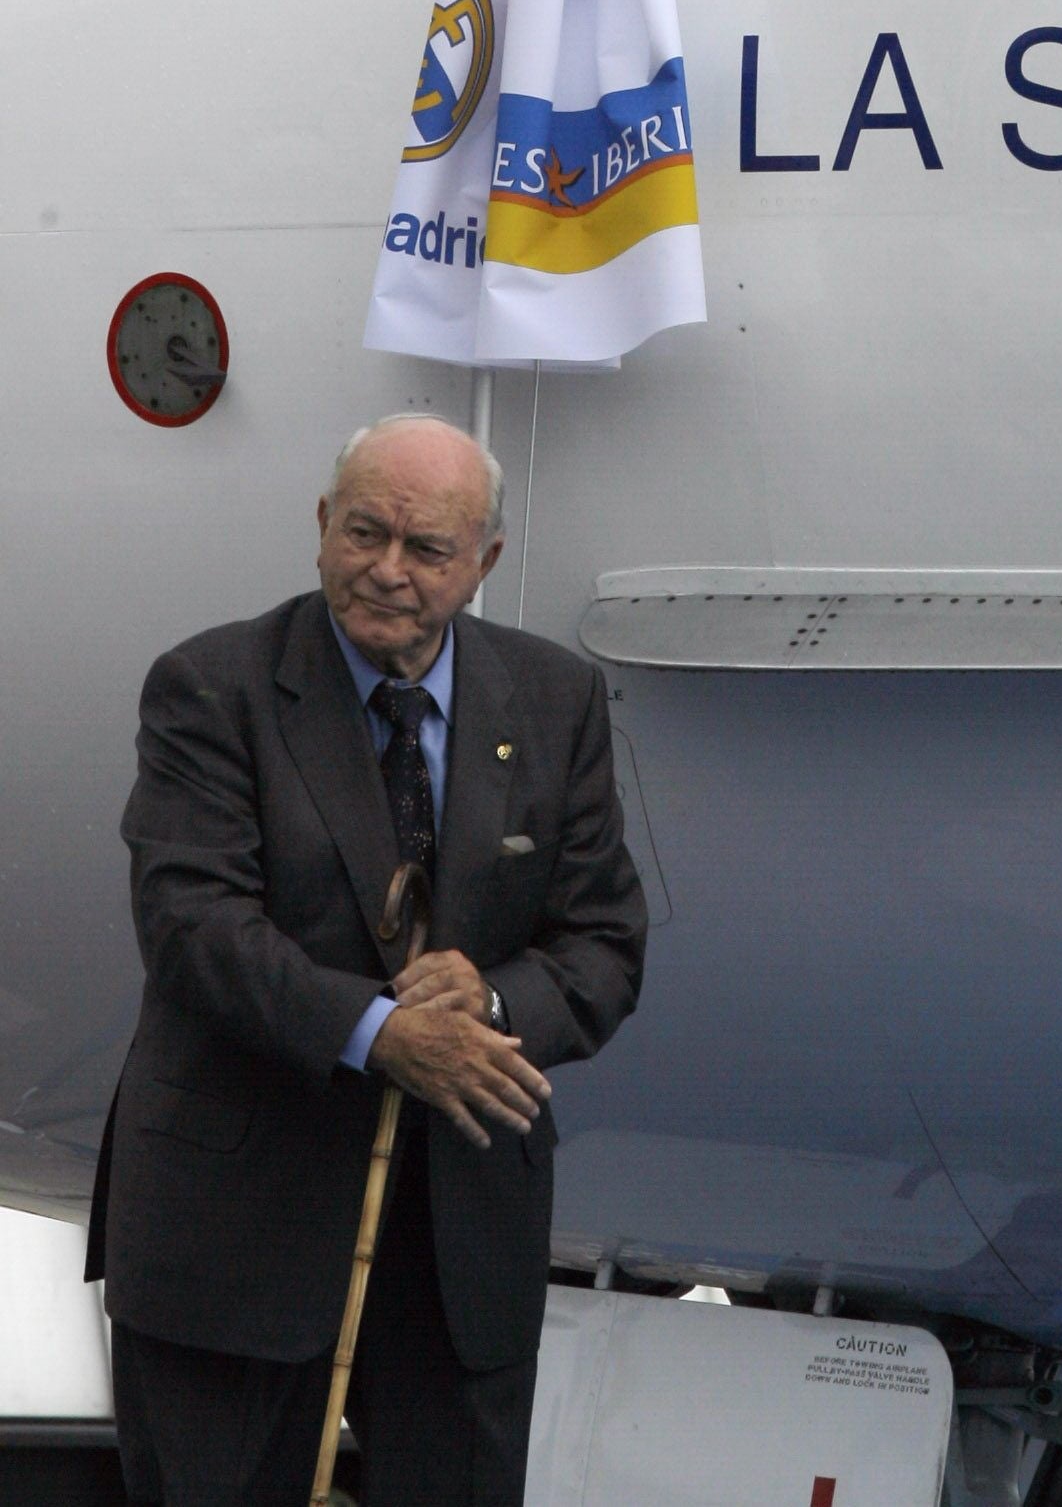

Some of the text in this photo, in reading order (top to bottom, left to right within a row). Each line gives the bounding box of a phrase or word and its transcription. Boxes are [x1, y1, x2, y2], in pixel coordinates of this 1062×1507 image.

[739, 32, 944, 173] LA
[492, 141, 547, 195] ES
[591, 105, 693, 196] IBERI
[382, 210, 487, 269] adri
[836, 1335, 908, 1358] CAUTION
